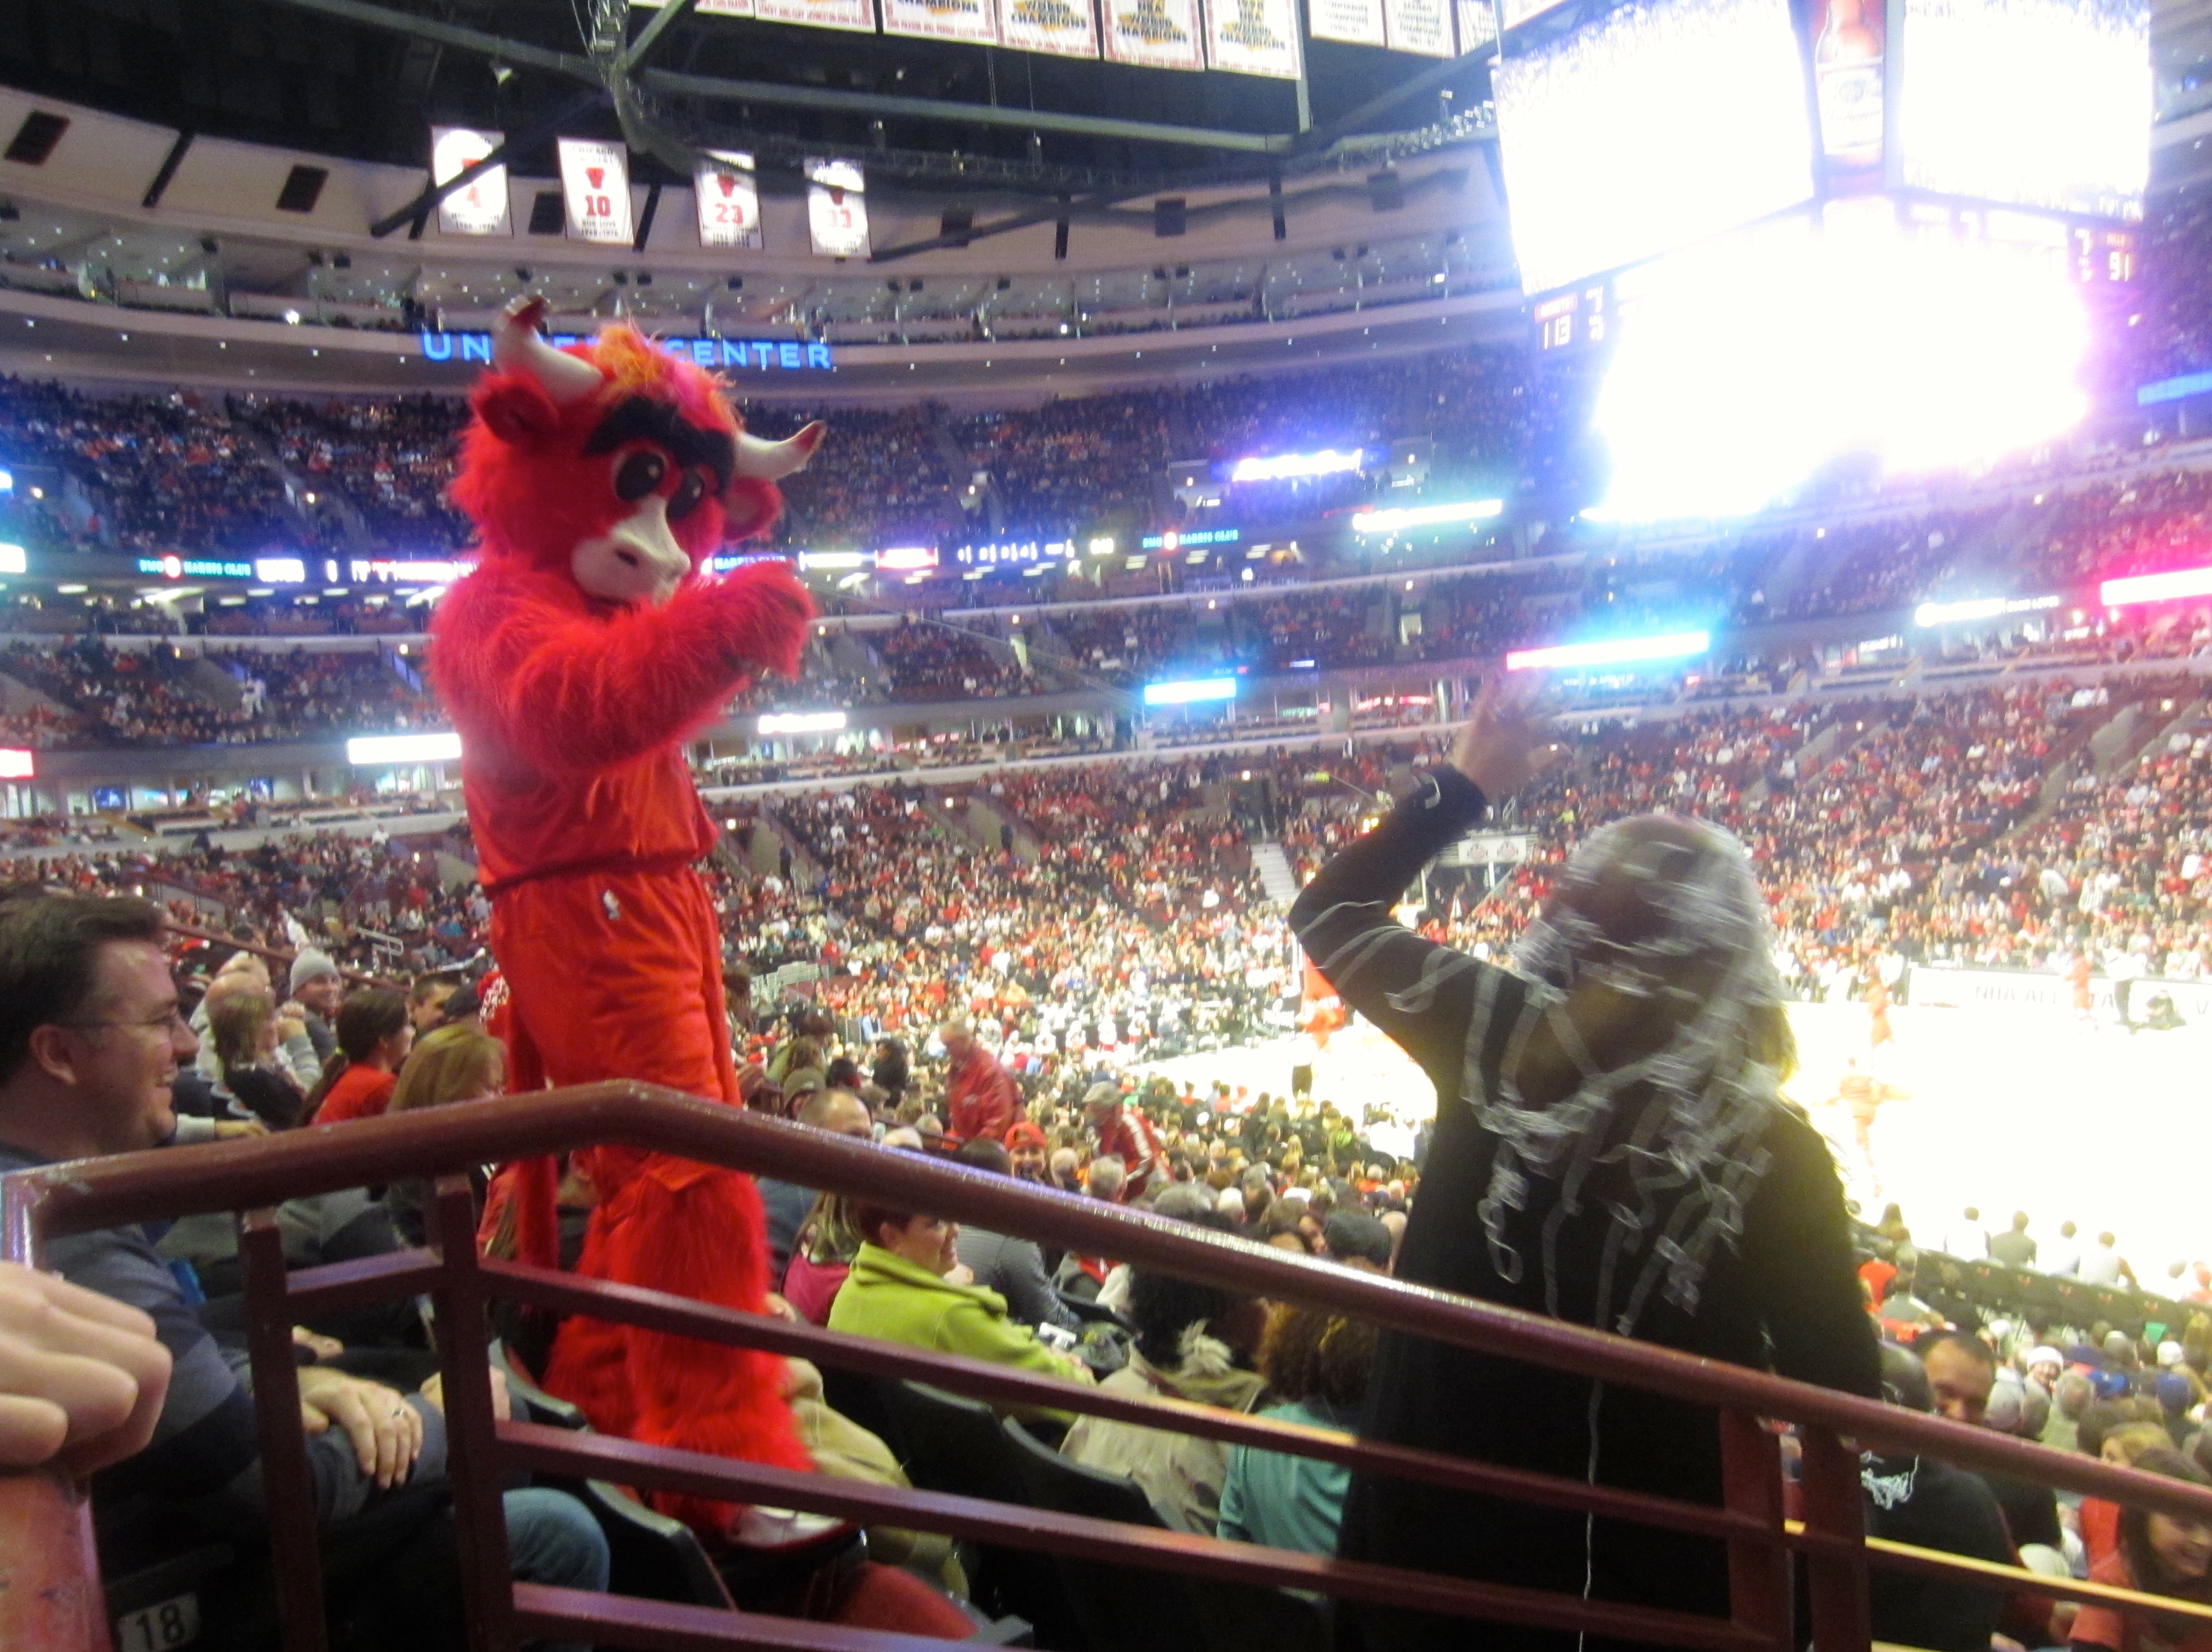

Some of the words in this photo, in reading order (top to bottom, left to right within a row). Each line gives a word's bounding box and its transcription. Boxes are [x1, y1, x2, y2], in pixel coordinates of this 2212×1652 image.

[585, 194, 611, 217] 10
[715, 202, 744, 224] 23
[663, 338, 831, 370] CENTER
[136, 1603, 185, 1650] 18
